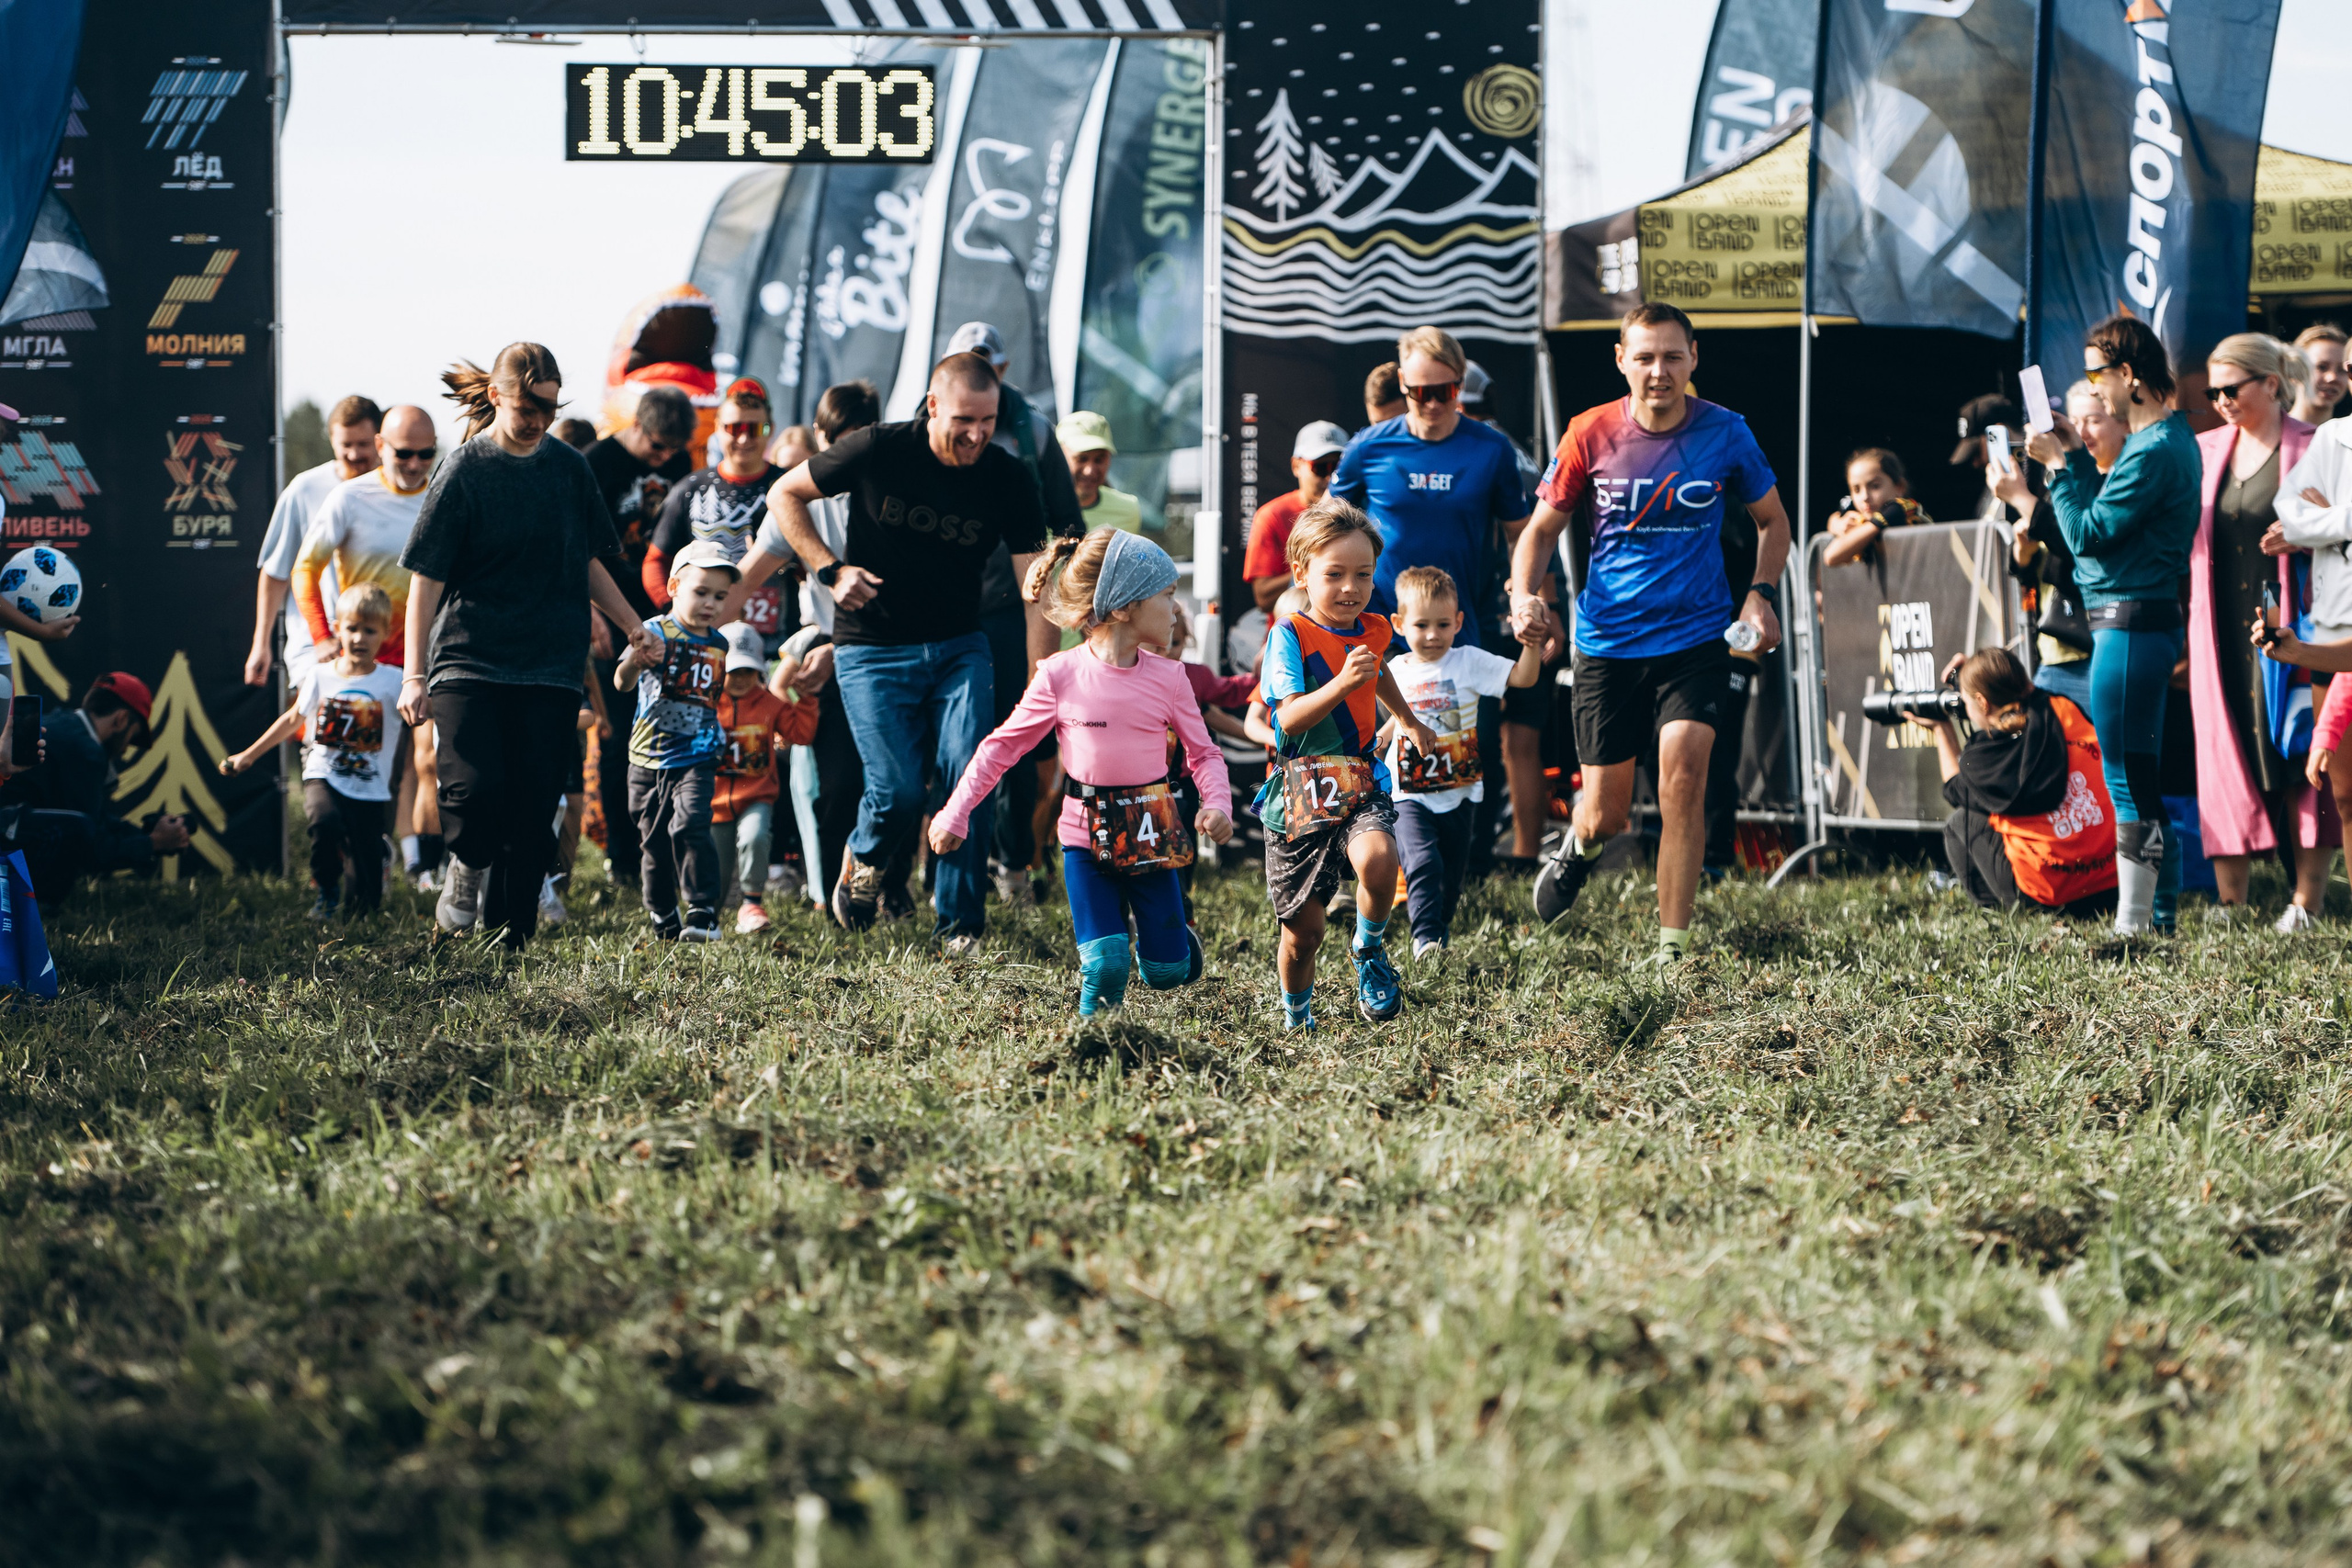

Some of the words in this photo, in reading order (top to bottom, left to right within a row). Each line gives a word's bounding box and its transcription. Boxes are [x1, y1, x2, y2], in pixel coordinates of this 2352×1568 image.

[578, 67, 934, 157] 10:45:03
[172, 152, 223, 180] ЛЁД
[3, 335, 67, 356] МГЛА
[146, 333, 246, 355] МОЛНИЯ
[173, 514, 232, 536] БУРЯ
[878, 496, 983, 547] BOSS
[1891, 602, 1934, 650] OPEN
[689, 661, 714, 689] 19
[1893, 651, 1936, 692] BAND
[340, 714, 355, 737] 7
[1071, 719, 1107, 728] Оськина
[1309, 761, 1335, 771] ЛИВЕНЬ
[1424, 751, 1453, 778] 21
[1135, 794, 1158, 805] ЛИВЕНЬ
[1304, 776, 1340, 810] 12
[1136, 811, 1159, 847] 4
